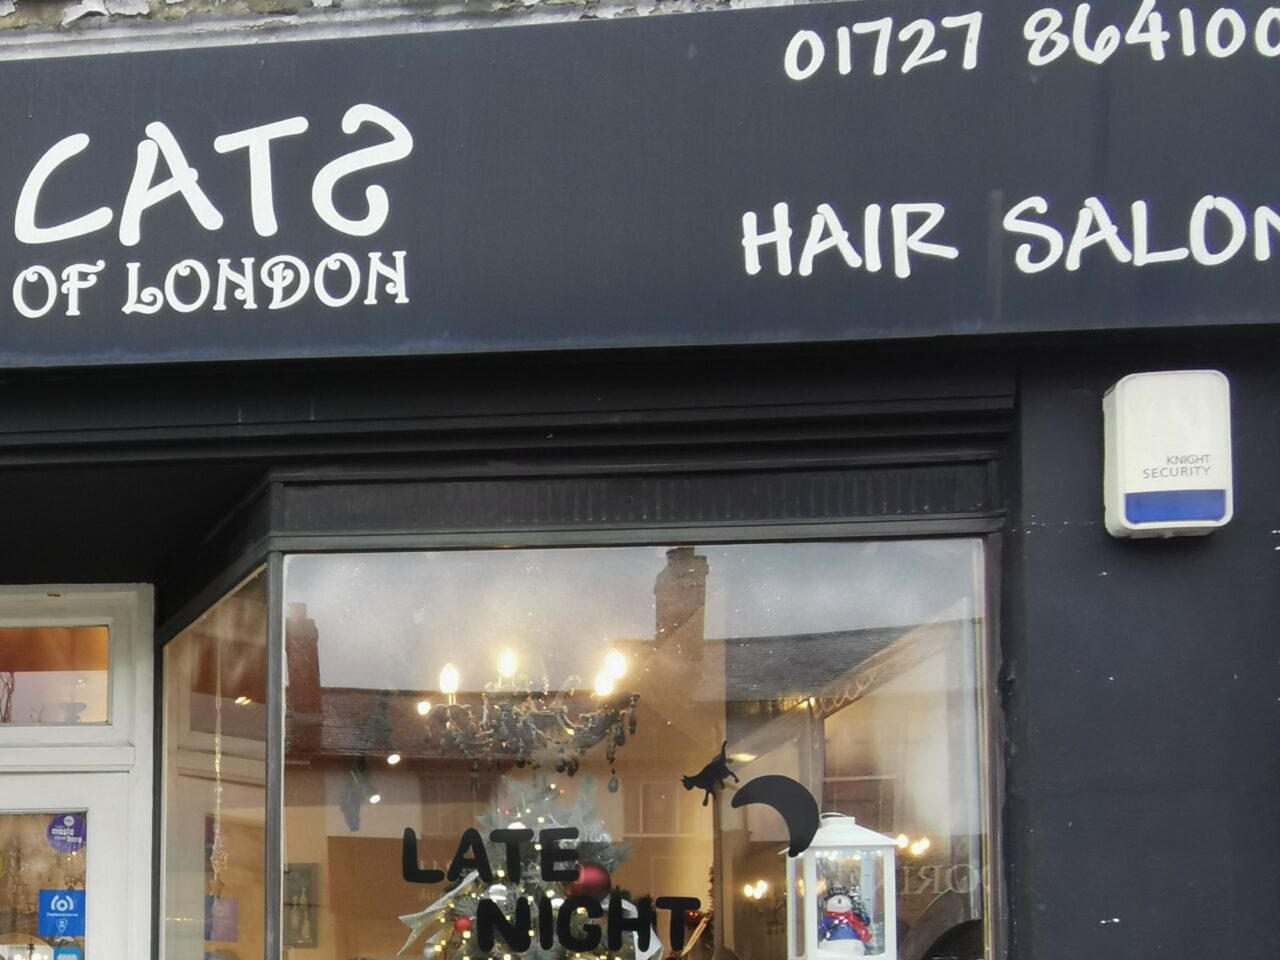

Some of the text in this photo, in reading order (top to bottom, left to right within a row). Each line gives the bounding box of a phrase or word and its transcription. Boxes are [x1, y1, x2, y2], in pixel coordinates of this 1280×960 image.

[784, 11, 982, 80] 01727
[15, 104, 413, 245] CATS
[742, 202, 958, 278] HAIR
[13, 251, 409, 318] OF LONDON
[1142, 466, 1211, 479] SECURITY
[1167, 454, 1211, 465] KNIGHT
[402, 827, 580, 884] LATE
[476, 897, 702, 953] NIGHT
